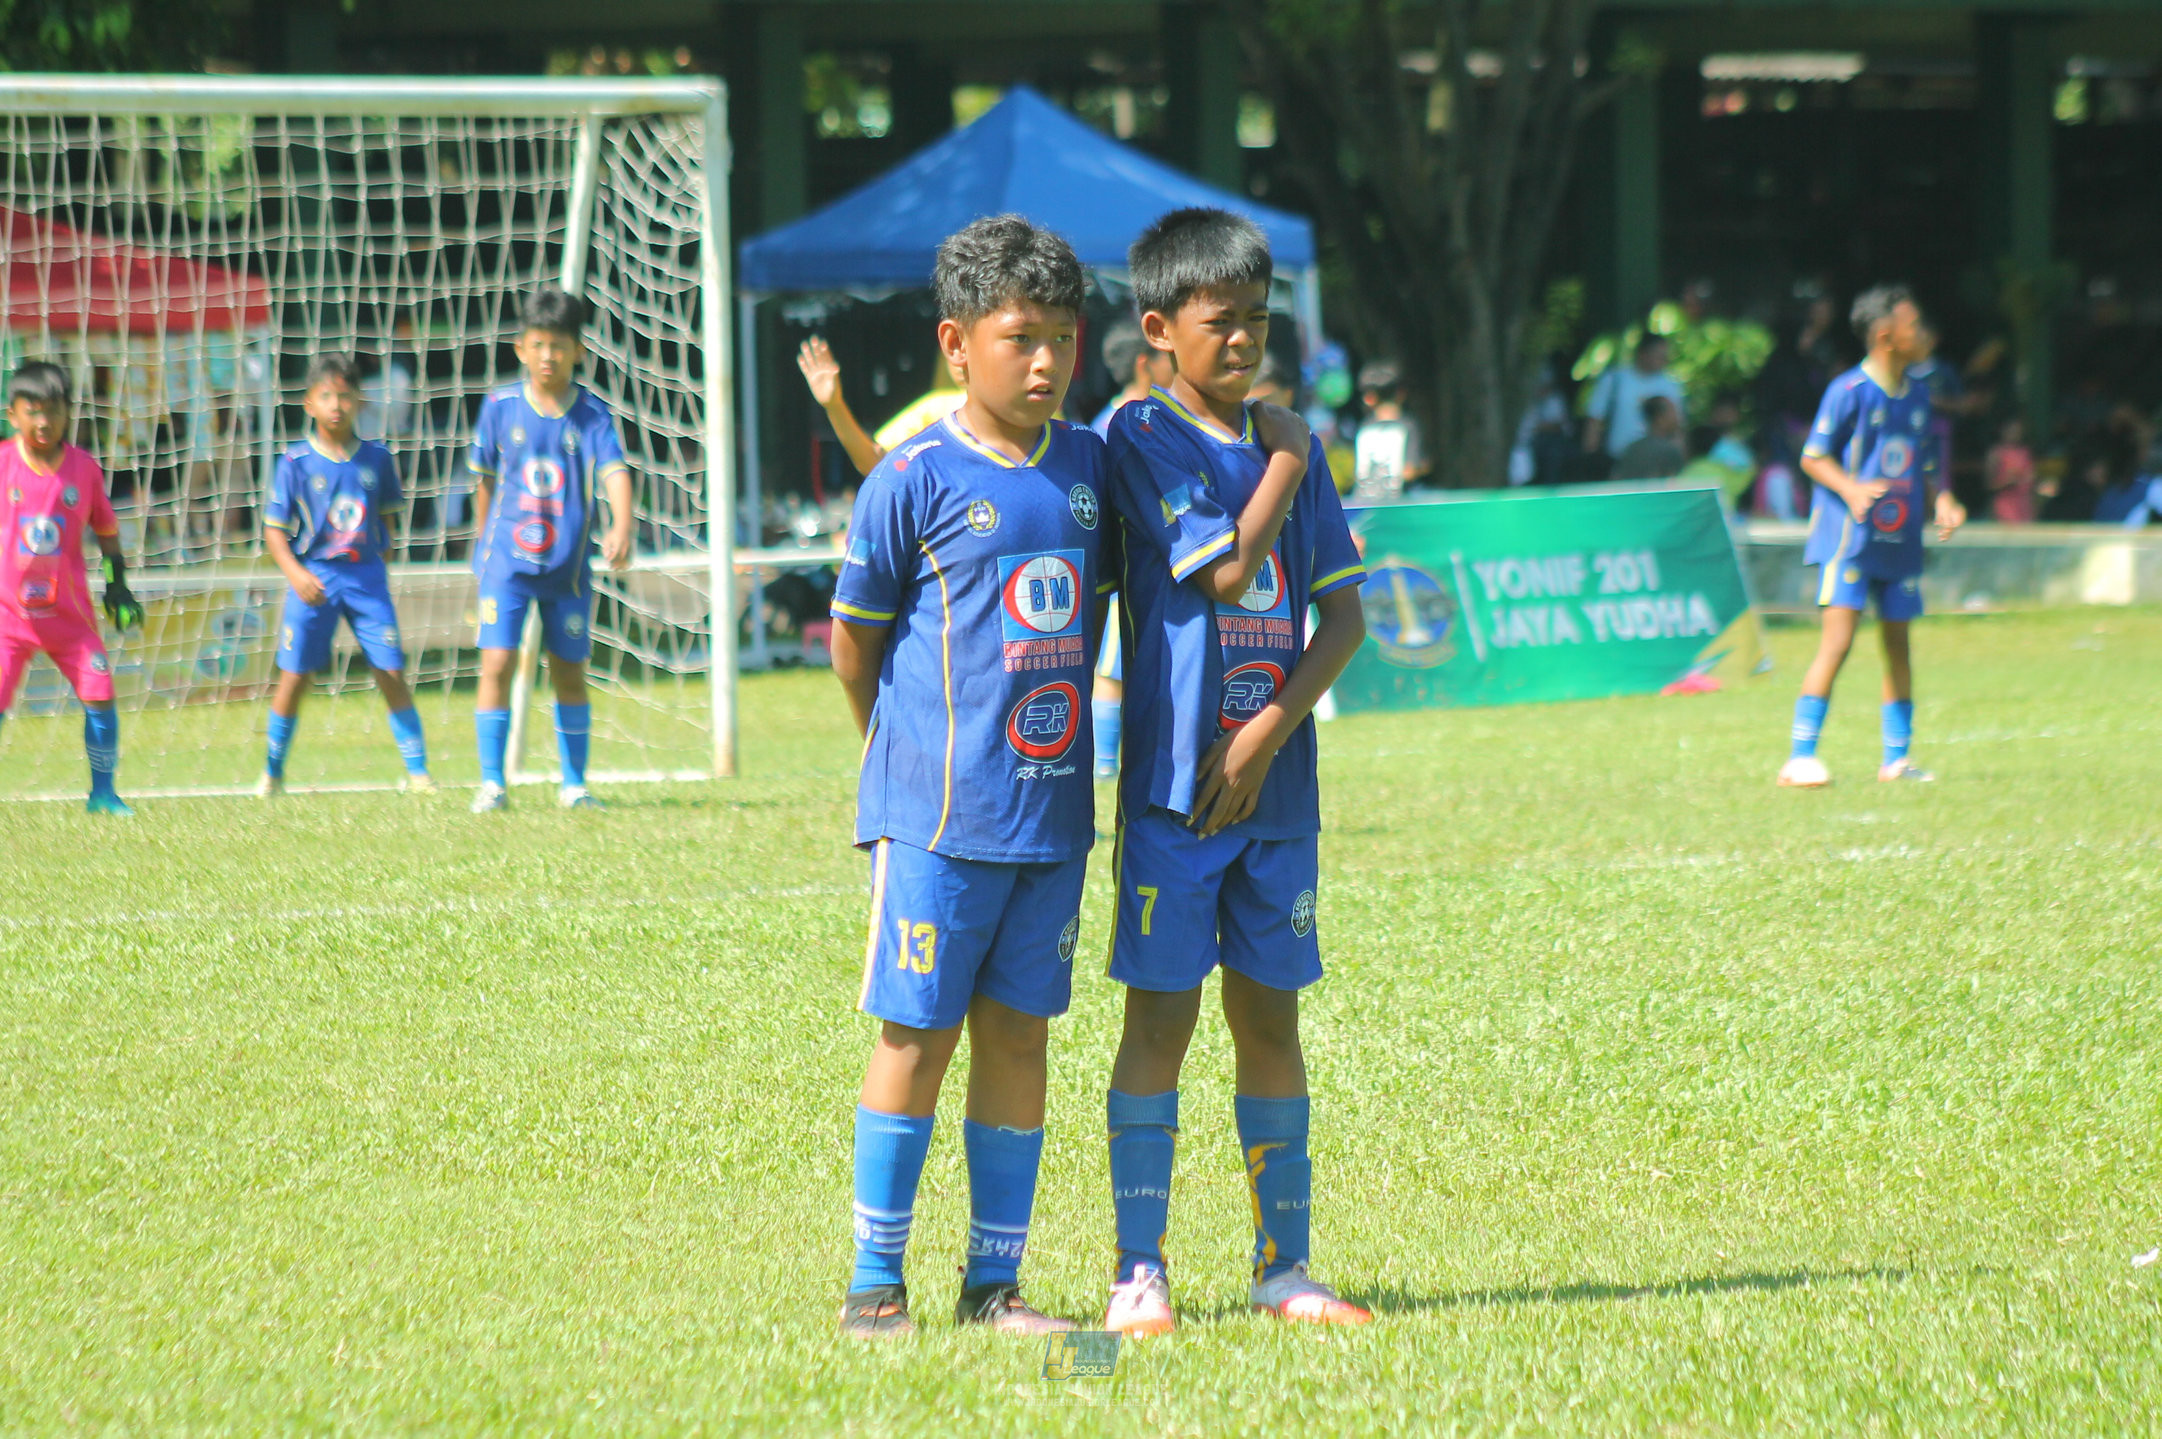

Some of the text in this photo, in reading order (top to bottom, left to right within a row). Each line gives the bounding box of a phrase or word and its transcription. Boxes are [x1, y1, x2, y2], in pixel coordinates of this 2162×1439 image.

[1472, 549, 1661, 600] YONIF 201
[1029, 577, 1070, 612] BM
[1216, 617, 1262, 633] INTANG
[1490, 592, 1720, 650] JAYA YUDHA
[1003, 639, 1057, 659] BINTANG
[1220, 632, 1264, 647] OCCER
[1004, 652, 1084, 673] SOCCER FIELD
[1222, 682, 1274, 711] RK
[1022, 703, 1069, 735] RK
[1016, 766, 1039, 780] RK
[1137, 885, 1159, 936] 7
[897, 918, 938, 975] 13
[1115, 1188, 1167, 1200] EURO
